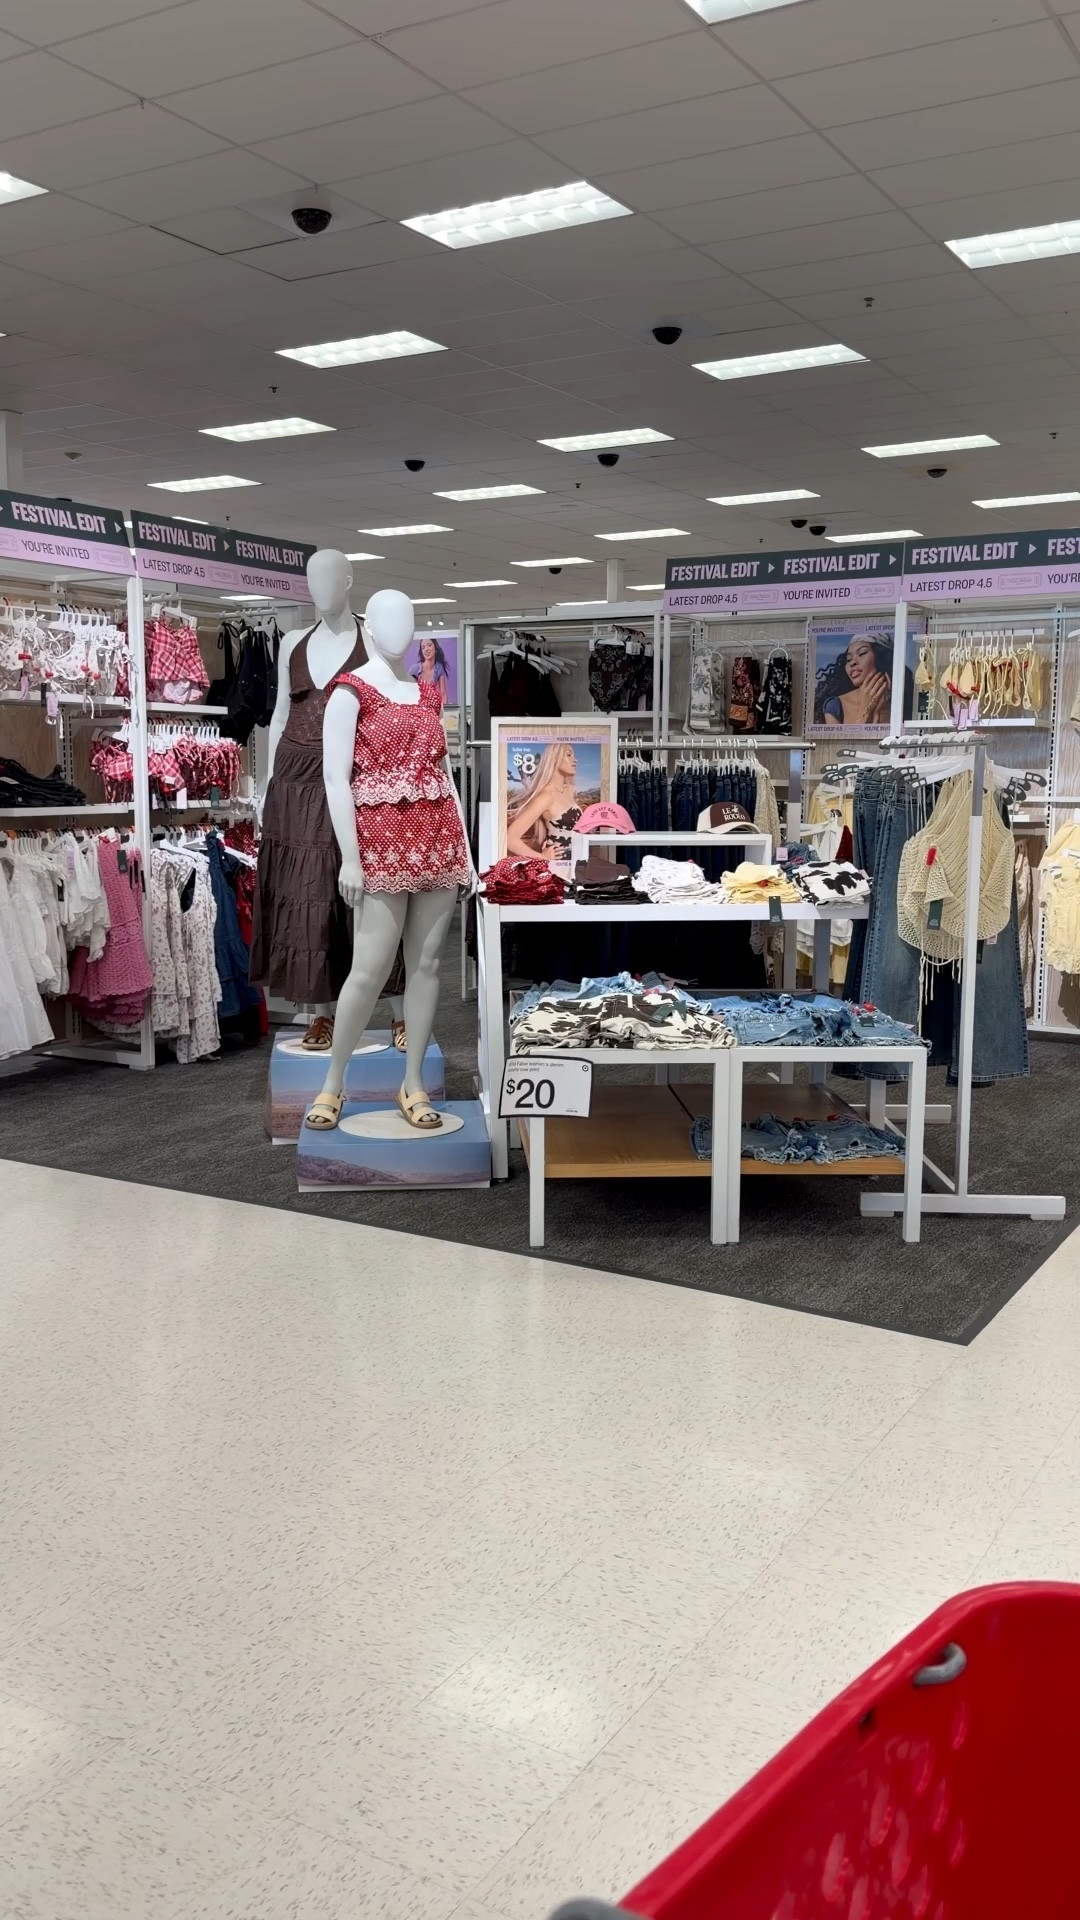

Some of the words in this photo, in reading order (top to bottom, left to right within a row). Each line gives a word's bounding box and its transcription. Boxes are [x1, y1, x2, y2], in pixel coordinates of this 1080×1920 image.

[11, 502, 78, 530] FESTIVAL
[77, 513, 106, 534] EDIT
[21, 539, 54, 554] YOU'RE
[55, 545, 90, 559] INVITED
[138, 521, 192, 547] FESTIVAL
[192, 532, 216, 552] EDIT
[236, 540, 283, 564] FESTIVAL
[283, 549, 304, 567] EDIT
[912, 544, 980, 565] FESTIVAL
[983, 541, 1018, 561] EDIT
[143, 558, 171, 573] LATEST
[172, 562, 193, 576] DROP
[194, 567, 205, 578] 4.5
[241, 573, 264, 586] YOU'RE
[264, 578, 290, 591] INVITED
[671, 563, 728, 582] FESTIVAL
[730, 561, 760, 578] EDIT
[783, 555, 846, 574] FESTIVAL
[848, 553, 880, 571] EDIT
[669, 595, 700, 606] LATEST
[701, 594, 724, 605] DROP
[725, 594, 738, 603] 4.5
[783, 589, 814, 600] YOU'RE
[815, 587, 851, 599] INVITED
[910, 580, 946, 592] LATEST
[948, 579, 975, 590] DROP
[977, 578, 992, 588] 4.5
[513, 753, 536, 774] $8
[506, 1078, 555, 1109] $20
